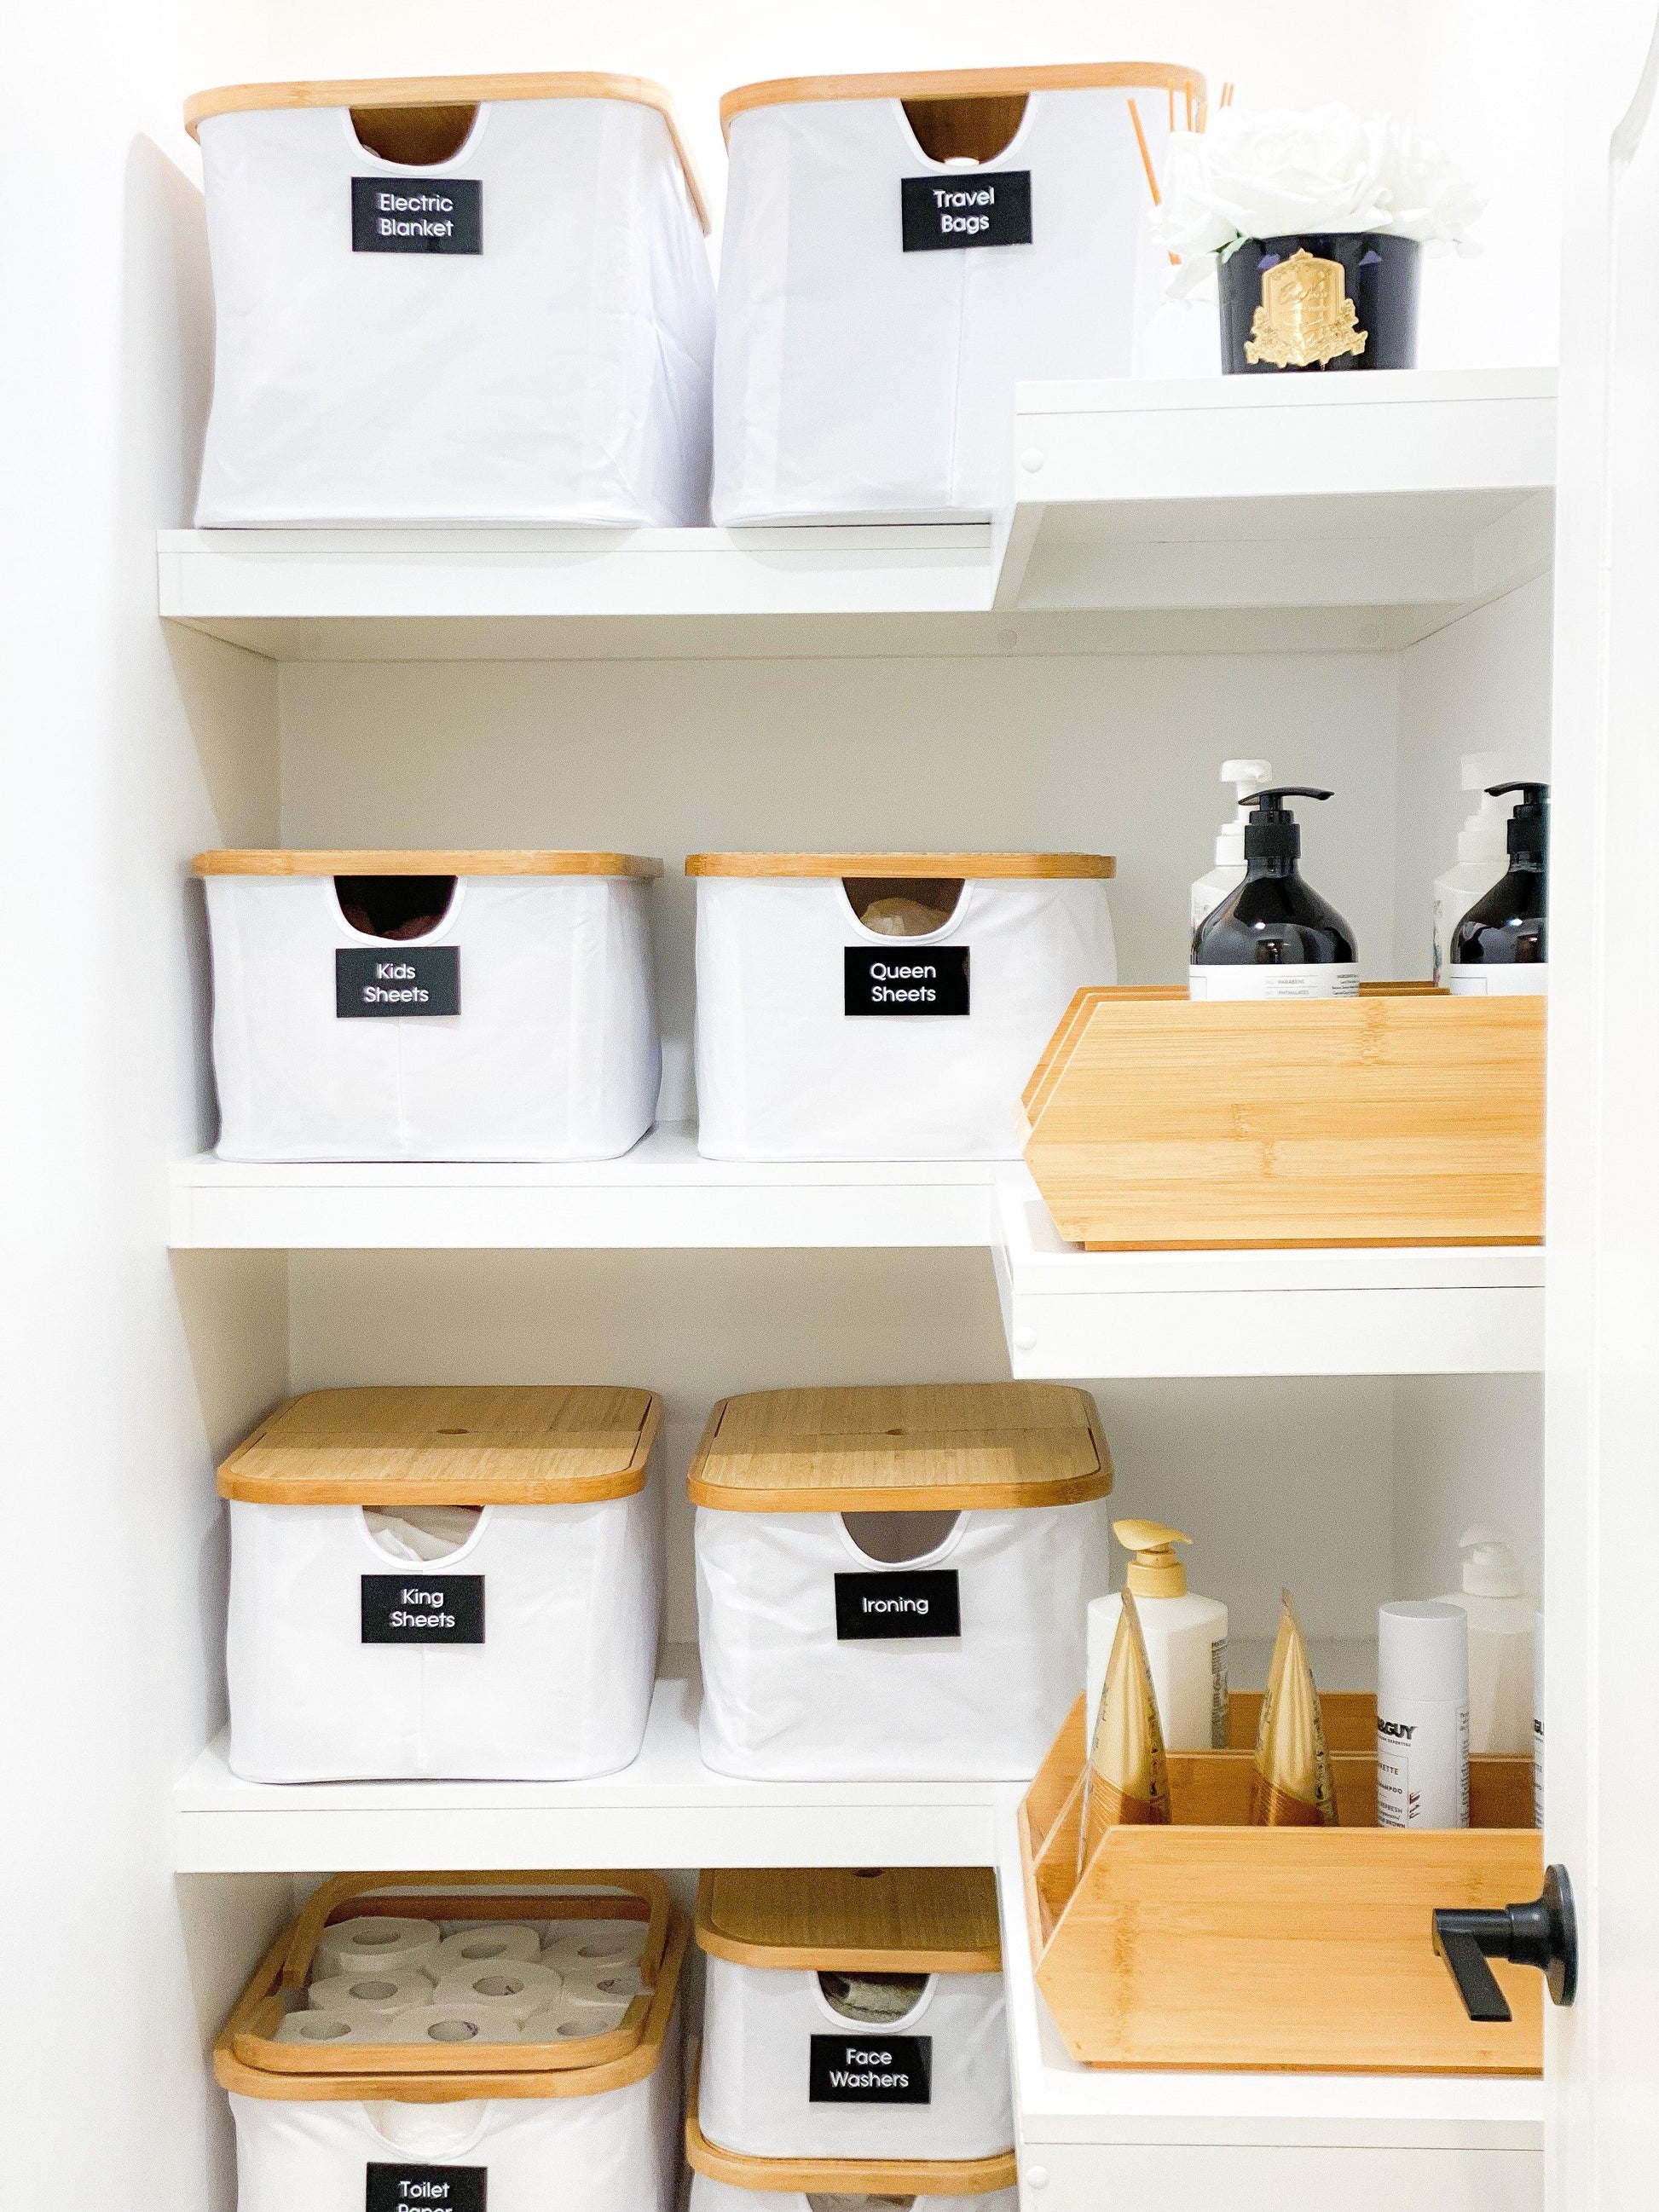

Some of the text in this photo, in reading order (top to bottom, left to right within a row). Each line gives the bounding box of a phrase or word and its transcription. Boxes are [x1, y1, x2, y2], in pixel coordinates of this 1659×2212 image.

[379, 192, 454, 212] Electric
[933, 186, 995, 209] Travel
[380, 217, 454, 237] Blanket
[940, 214, 990, 234] Bags
[376, 963, 416, 979] Kids
[870, 962, 937, 980] Queen
[364, 986, 430, 1002] Sheets
[871, 985, 937, 1002] Sheets
[402, 1588, 444, 1608] King
[863, 1597, 929, 1615] Ironing
[390, 1610, 456, 1628] Sheets
[846, 2047, 893, 2065] Face
[830, 2071, 910, 2088] Washers
[397, 2180, 450, 2198] Toilet
